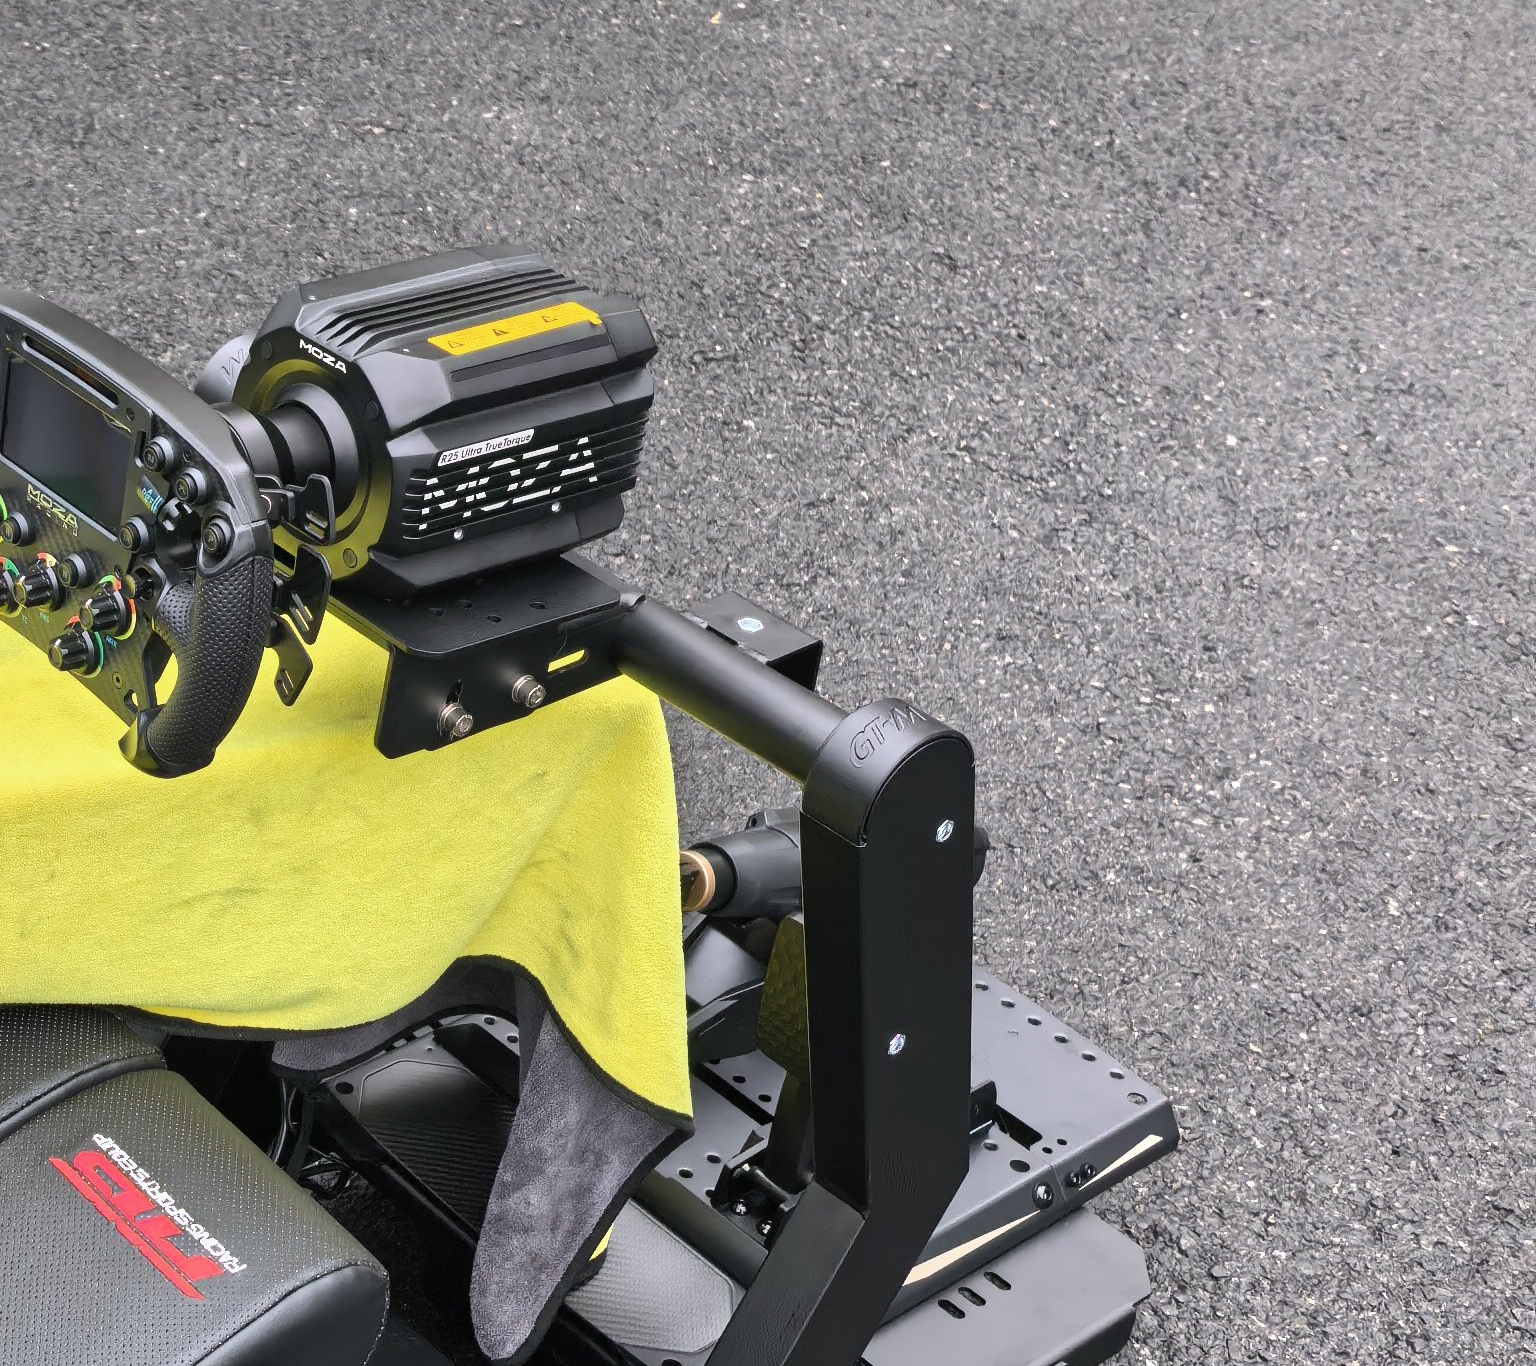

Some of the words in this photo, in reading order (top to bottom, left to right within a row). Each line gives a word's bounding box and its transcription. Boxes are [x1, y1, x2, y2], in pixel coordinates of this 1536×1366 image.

[299, 338, 347, 374] MOZA
[440, 451, 459, 465] R25
[461, 446, 482, 459] Ultra
[485, 434, 532, 453] TrueTorque
[27, 483, 78, 529] MOZA
[418, 436, 598, 531] MOZA
[850, 705, 927, 769] GT-M
